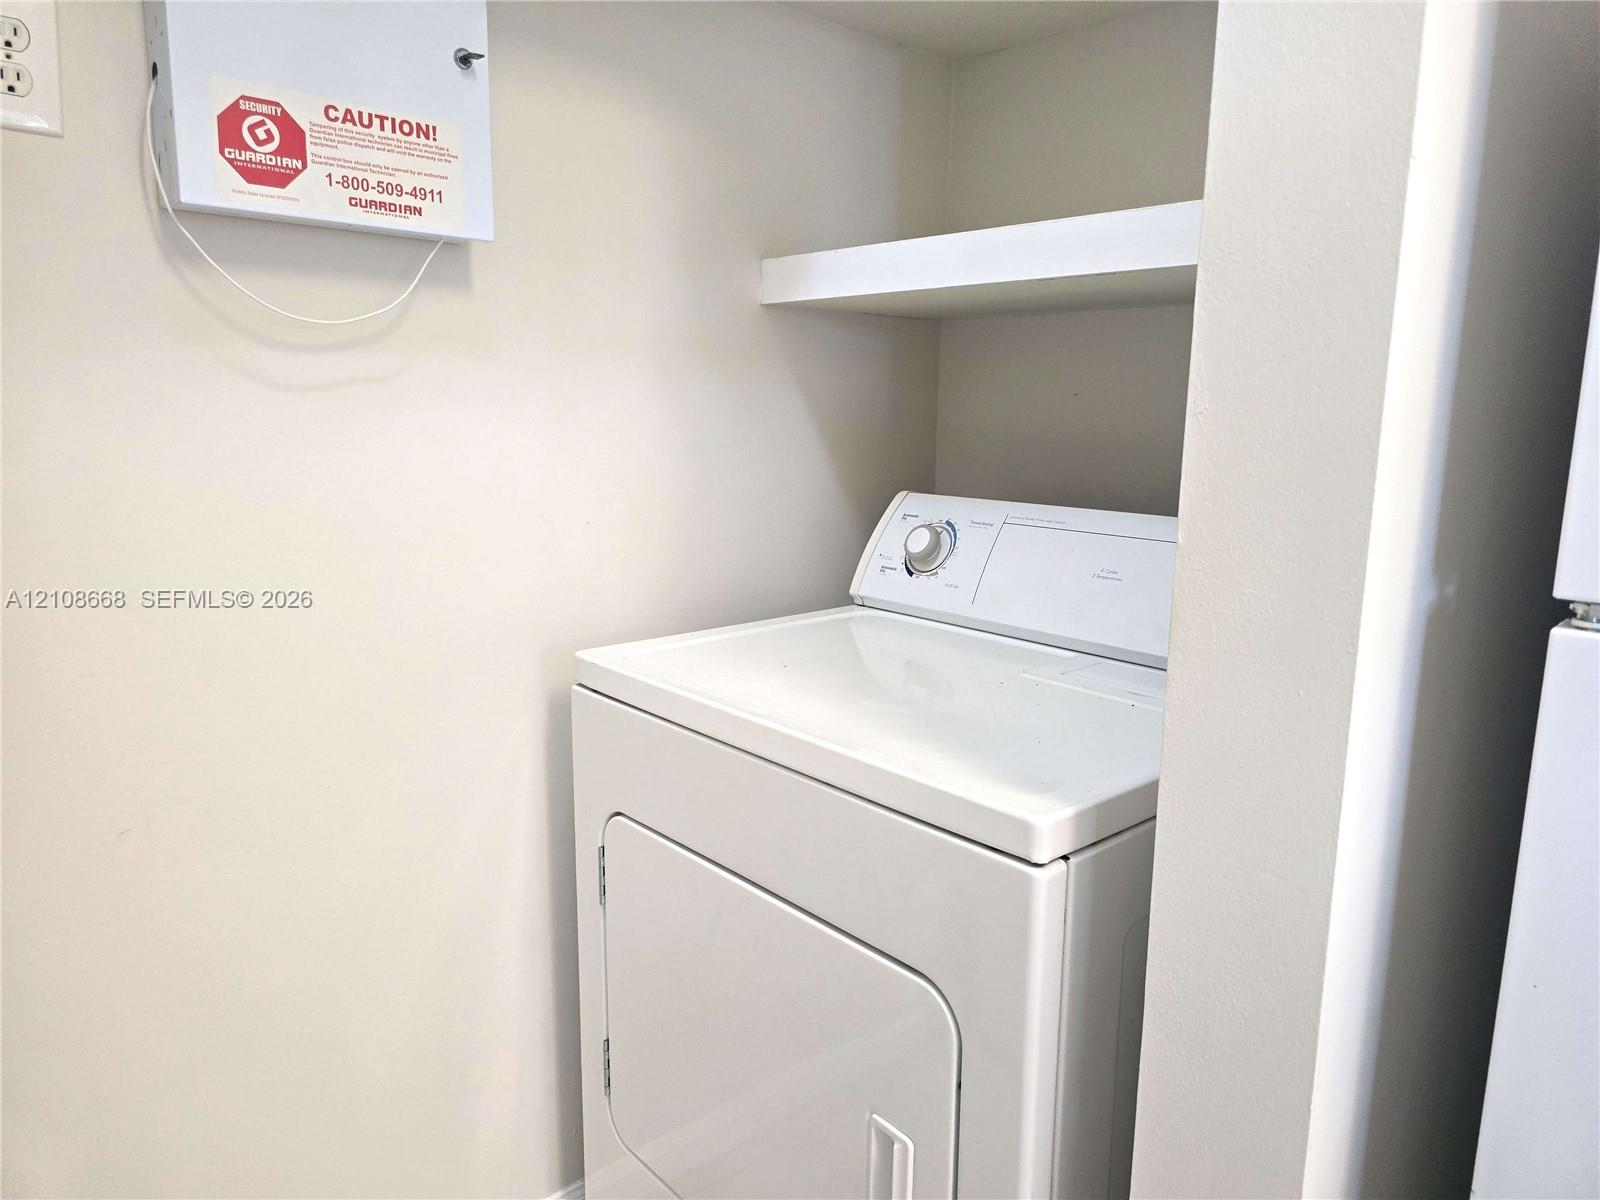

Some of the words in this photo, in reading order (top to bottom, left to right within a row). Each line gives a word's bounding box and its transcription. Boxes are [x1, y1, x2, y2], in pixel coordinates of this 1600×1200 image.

[240, 100, 282, 116] SECURITY
[309, 122, 336, 132] Tampering
[355, 131, 375, 139] security
[324, 104, 438, 142] CAUTION!
[309, 128, 334, 136] Guardian
[335, 132, 366, 142] International
[368, 139, 393, 147] technician
[424, 150, 446, 158] municipal
[224, 147, 302, 170] GUARDIAN
[311, 159, 335, 167] Guardian
[336, 163, 368, 172] International
[323, 154, 342, 162] control
[234, 161, 294, 175] INTERNATIONAL
[325, 172, 443, 204] 1-800-509-4911
[348, 196, 423, 217] GUARDIAN
[363, 209, 410, 220] INTERNATIONAL
